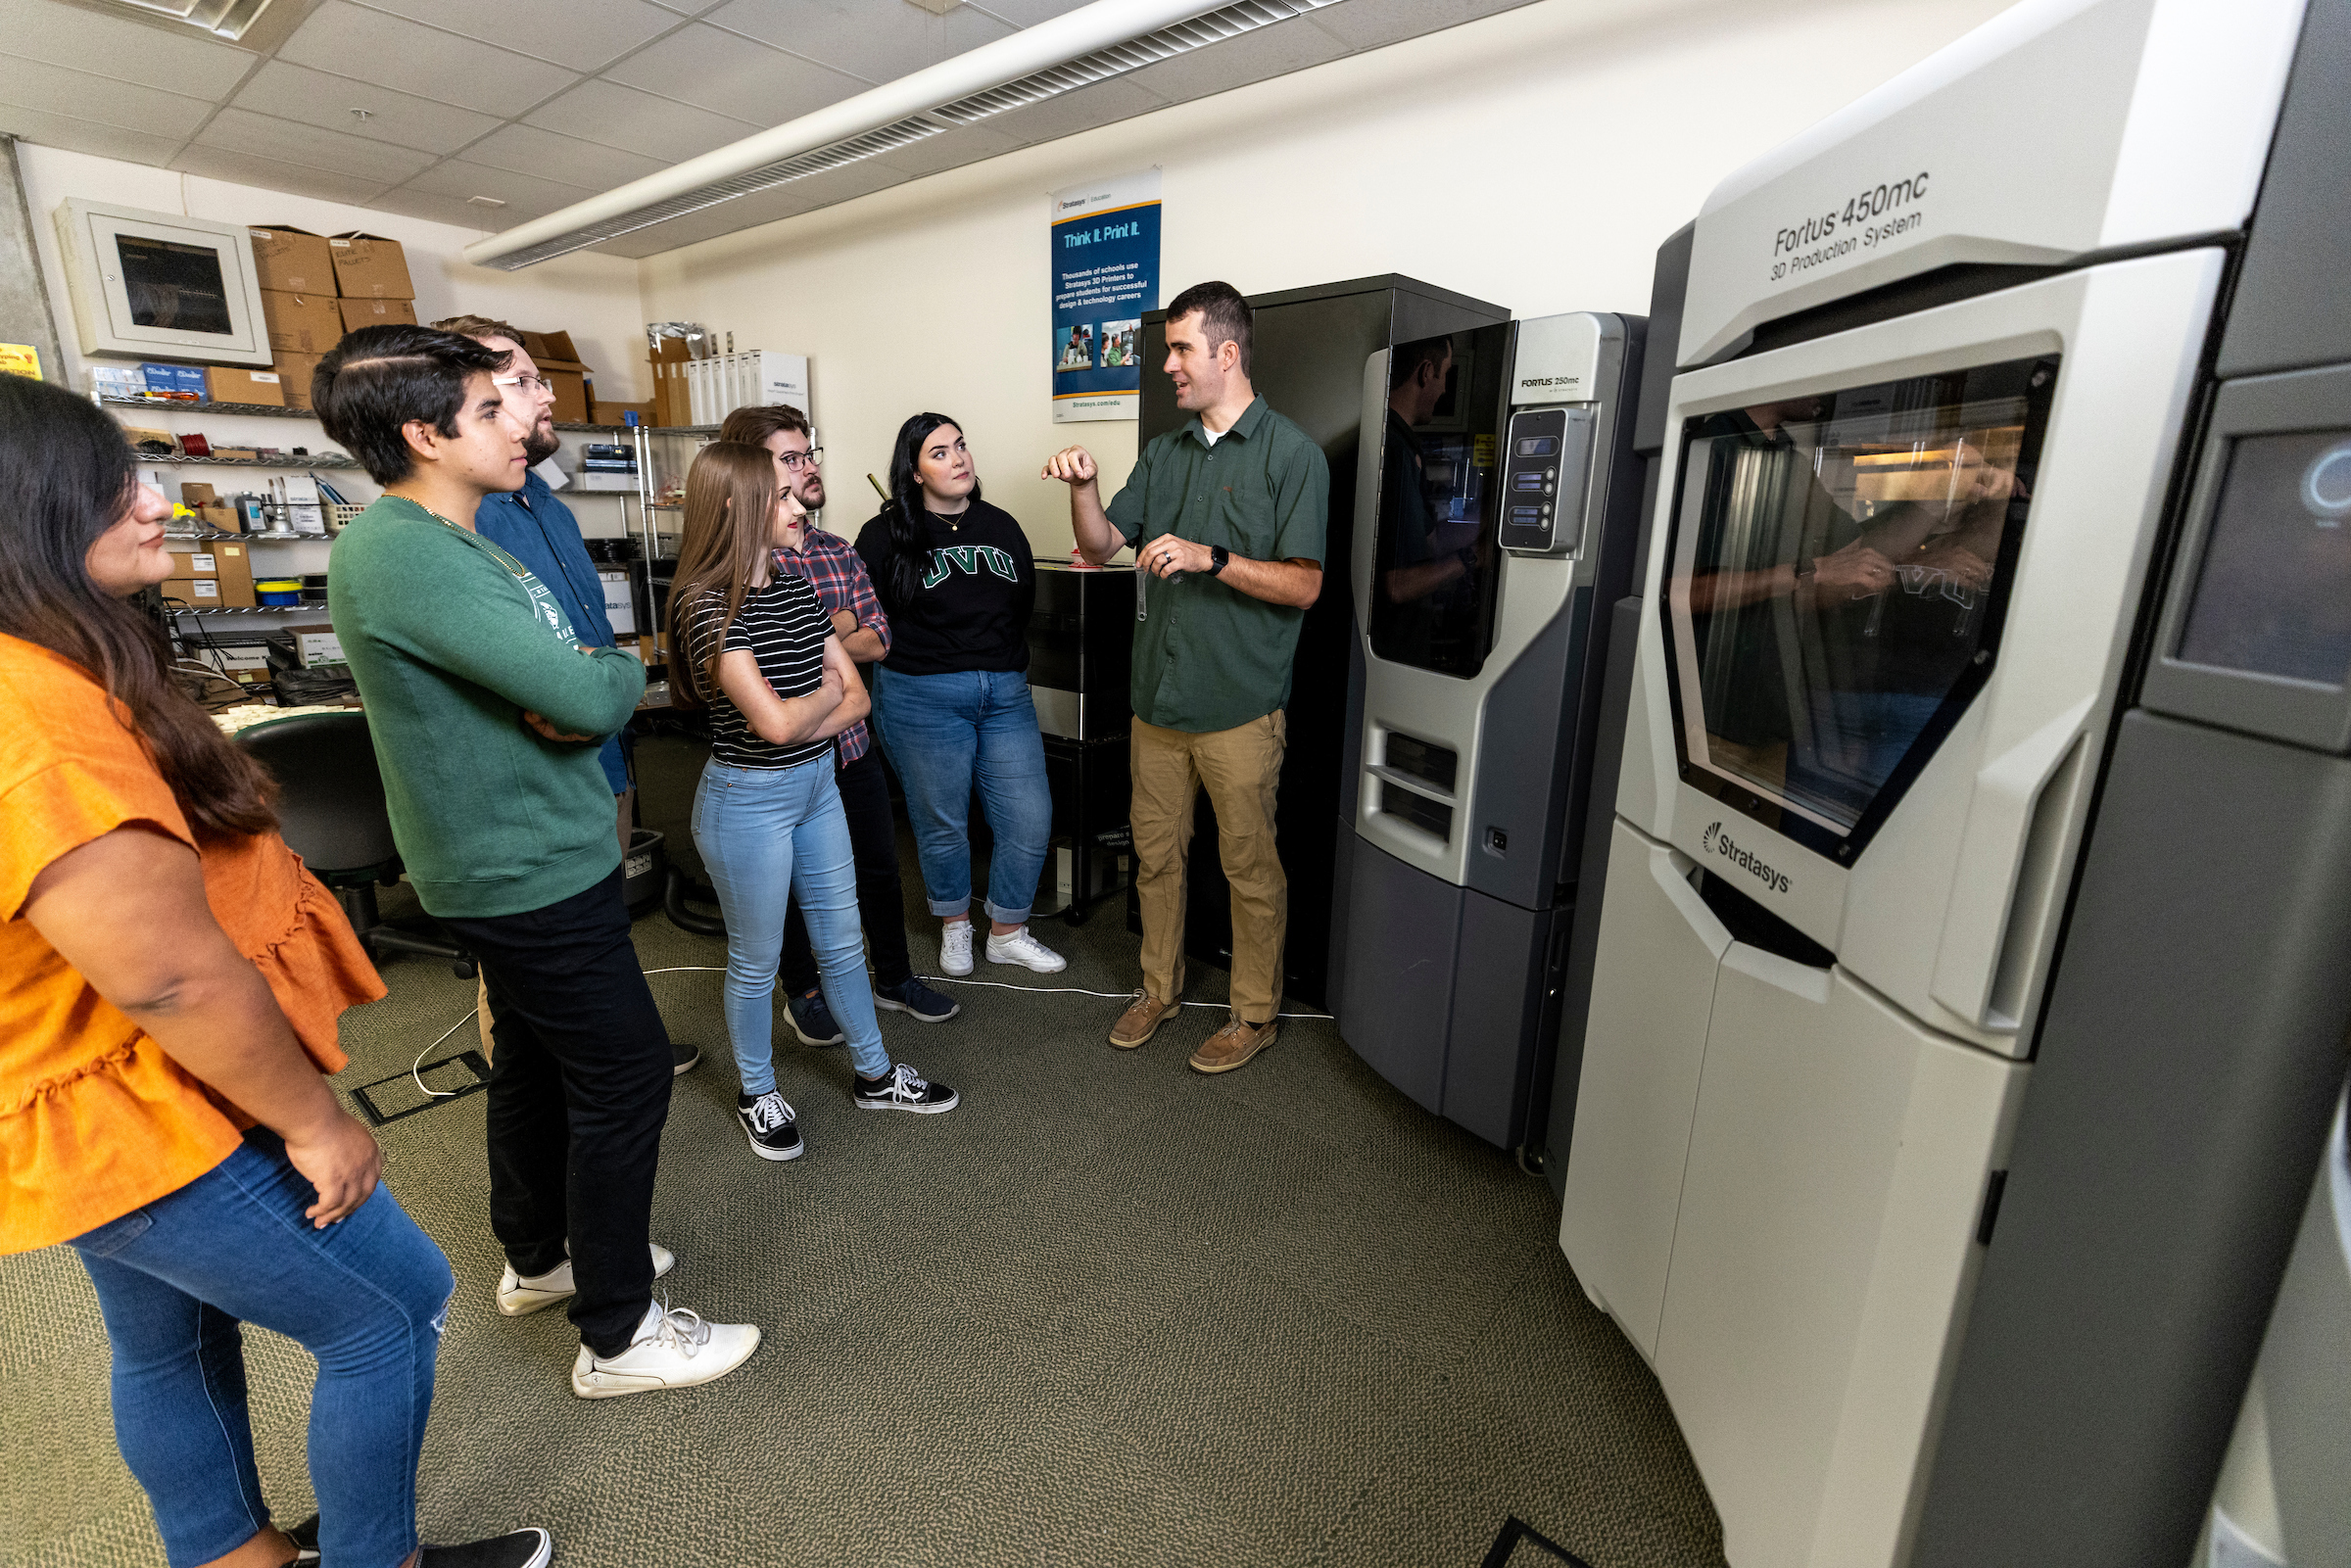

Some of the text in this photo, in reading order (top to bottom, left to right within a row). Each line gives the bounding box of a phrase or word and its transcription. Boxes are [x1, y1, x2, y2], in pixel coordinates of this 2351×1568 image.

[1063, 199, 1086, 209] Stratasys
[1774, 171, 1929, 257] Fortus 450mc
[1064, 230, 1091, 248] Think
[1104, 222, 1128, 241] Print
[1770, 212, 1922, 281] 3D Production System
[1062, 269, 1092, 280] Thousands
[1101, 263, 1126, 274] schools
[1056, 291, 1076, 302] prepare
[1076, 287, 1101, 297] students
[1112, 280, 1147, 292] successful
[1065, 279, 1091, 289] Stratasys
[1092, 276, 1101, 285] 3D
[1101, 274, 1126, 283] Printers
[1059, 301, 1078, 309] design
[1082, 295, 1116, 306] technology
[1117, 292, 1141, 301] careers
[1521, 376, 1580, 388] FORTUS 250mc
[920, 546, 1019, 590] UVU
[1097, 832, 1125, 841] prepare
[1718, 834, 1791, 893] Stratasys
